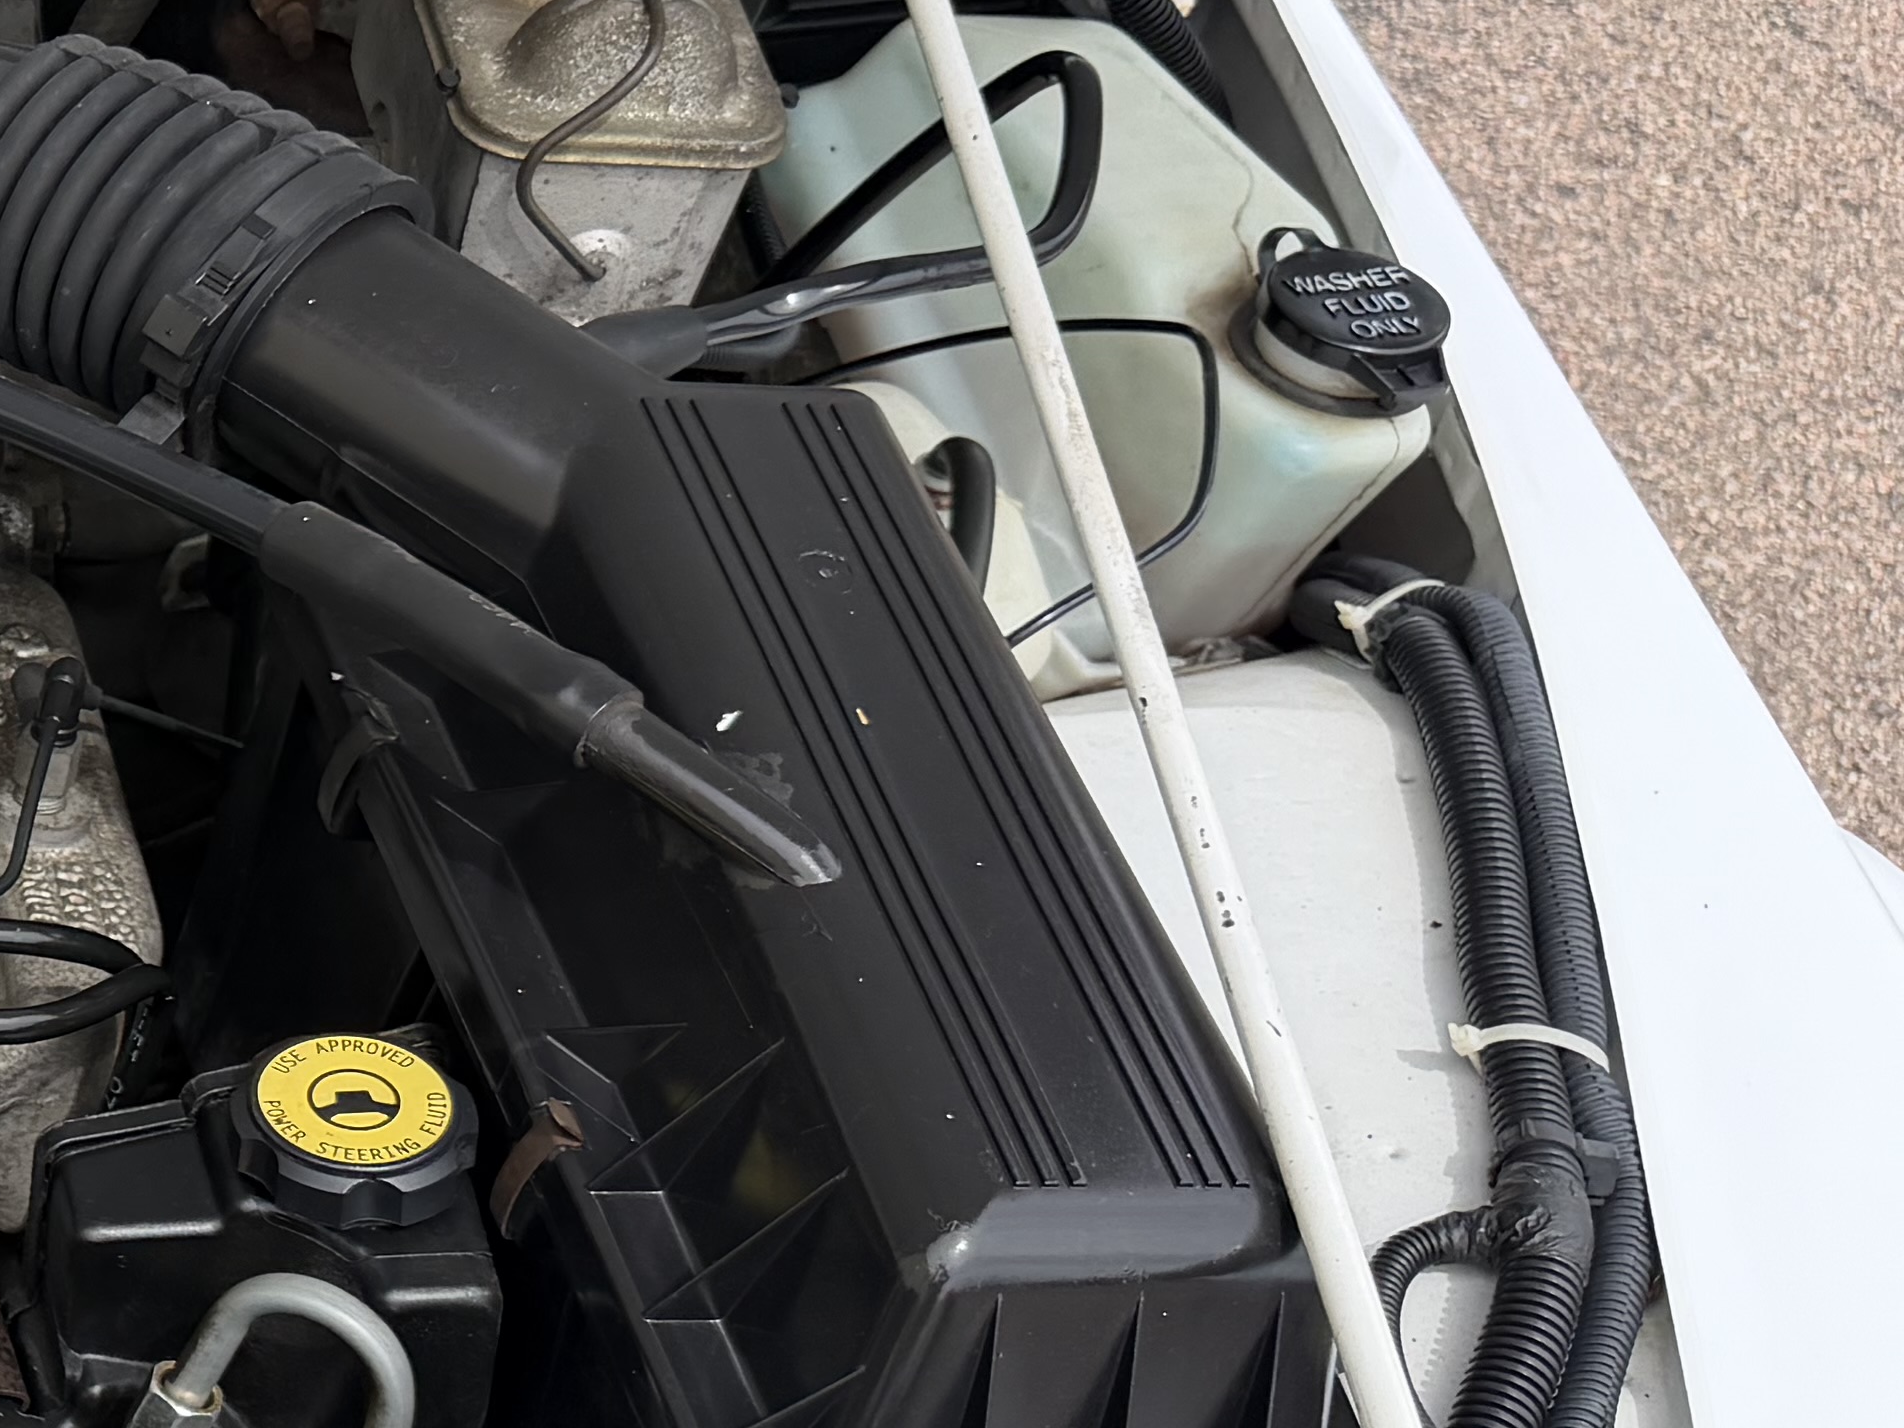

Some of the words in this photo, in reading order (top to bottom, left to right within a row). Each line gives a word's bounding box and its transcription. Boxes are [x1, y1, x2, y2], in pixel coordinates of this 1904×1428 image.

[1284, 266, 1411, 297] WASHER
[1323, 292, 1411, 318] FLUID
[1350, 315, 1420, 340] ONLY
[271, 1049, 307, 1075] USE
[315, 1039, 415, 1069] APPROVED
[263, 1099, 306, 1143] POWER
[315, 1137, 421, 1162] STEERING
[419, 1092, 446, 1136] FLUID
